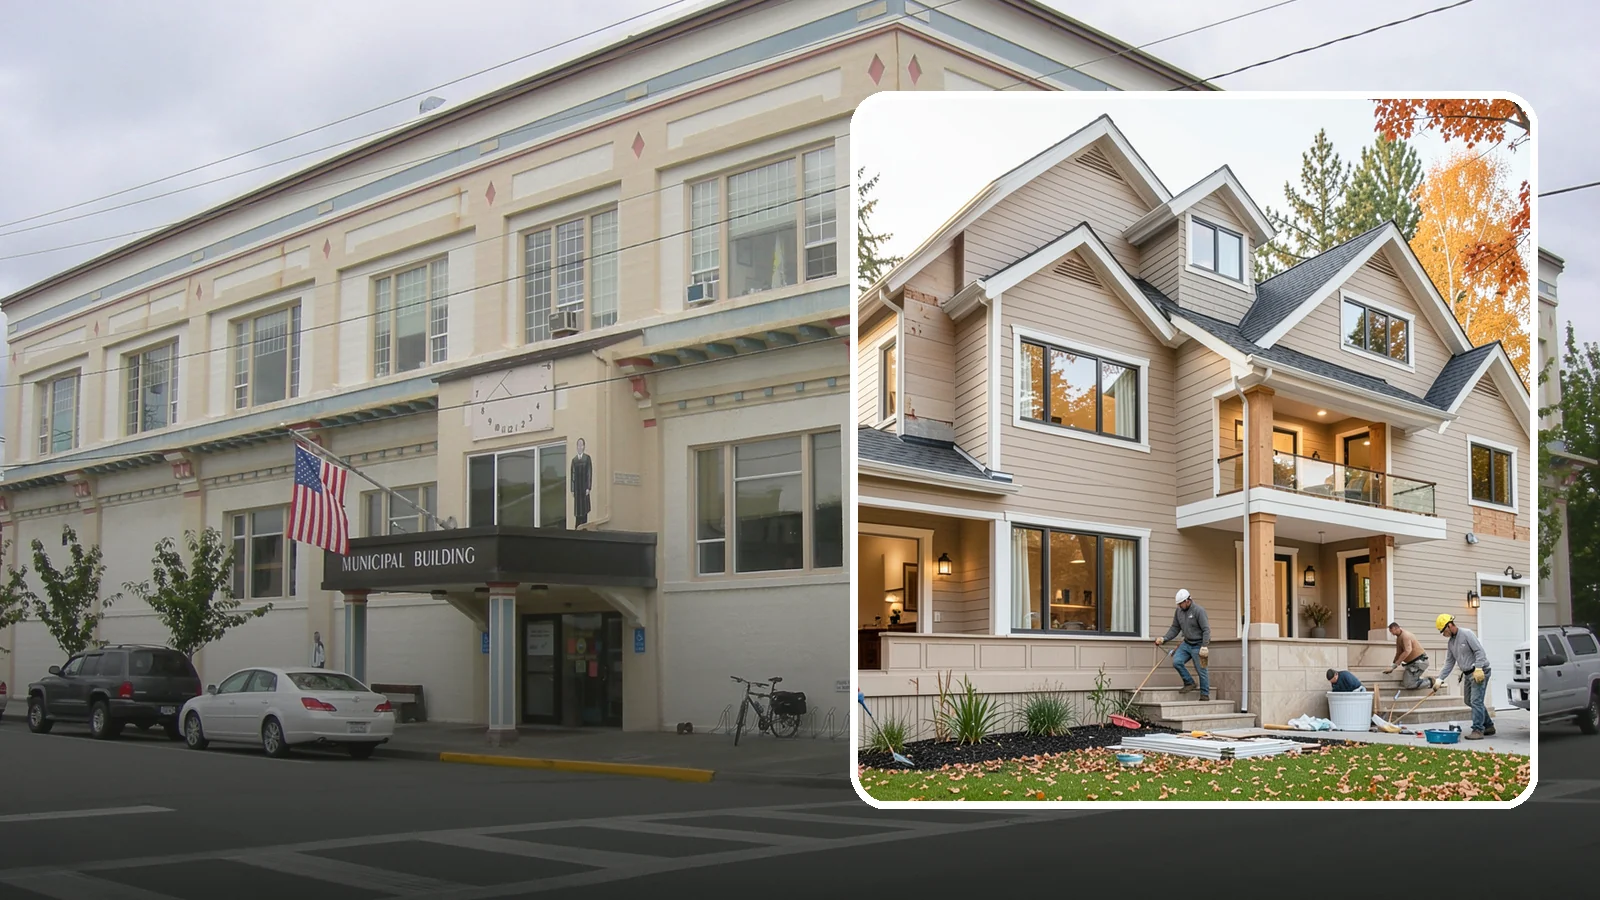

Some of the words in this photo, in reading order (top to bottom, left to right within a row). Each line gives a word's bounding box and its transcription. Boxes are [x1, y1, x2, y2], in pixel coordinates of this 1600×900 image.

[480, 406, 485, 415] 8
[488, 417, 492, 426] 9
[507, 426, 513, 434] 12
[521, 420, 526, 428] 2
[529, 414, 533, 422] 3
[341, 552, 406, 572] MUNICIPAL
[414, 546, 476, 568] BUILDING
